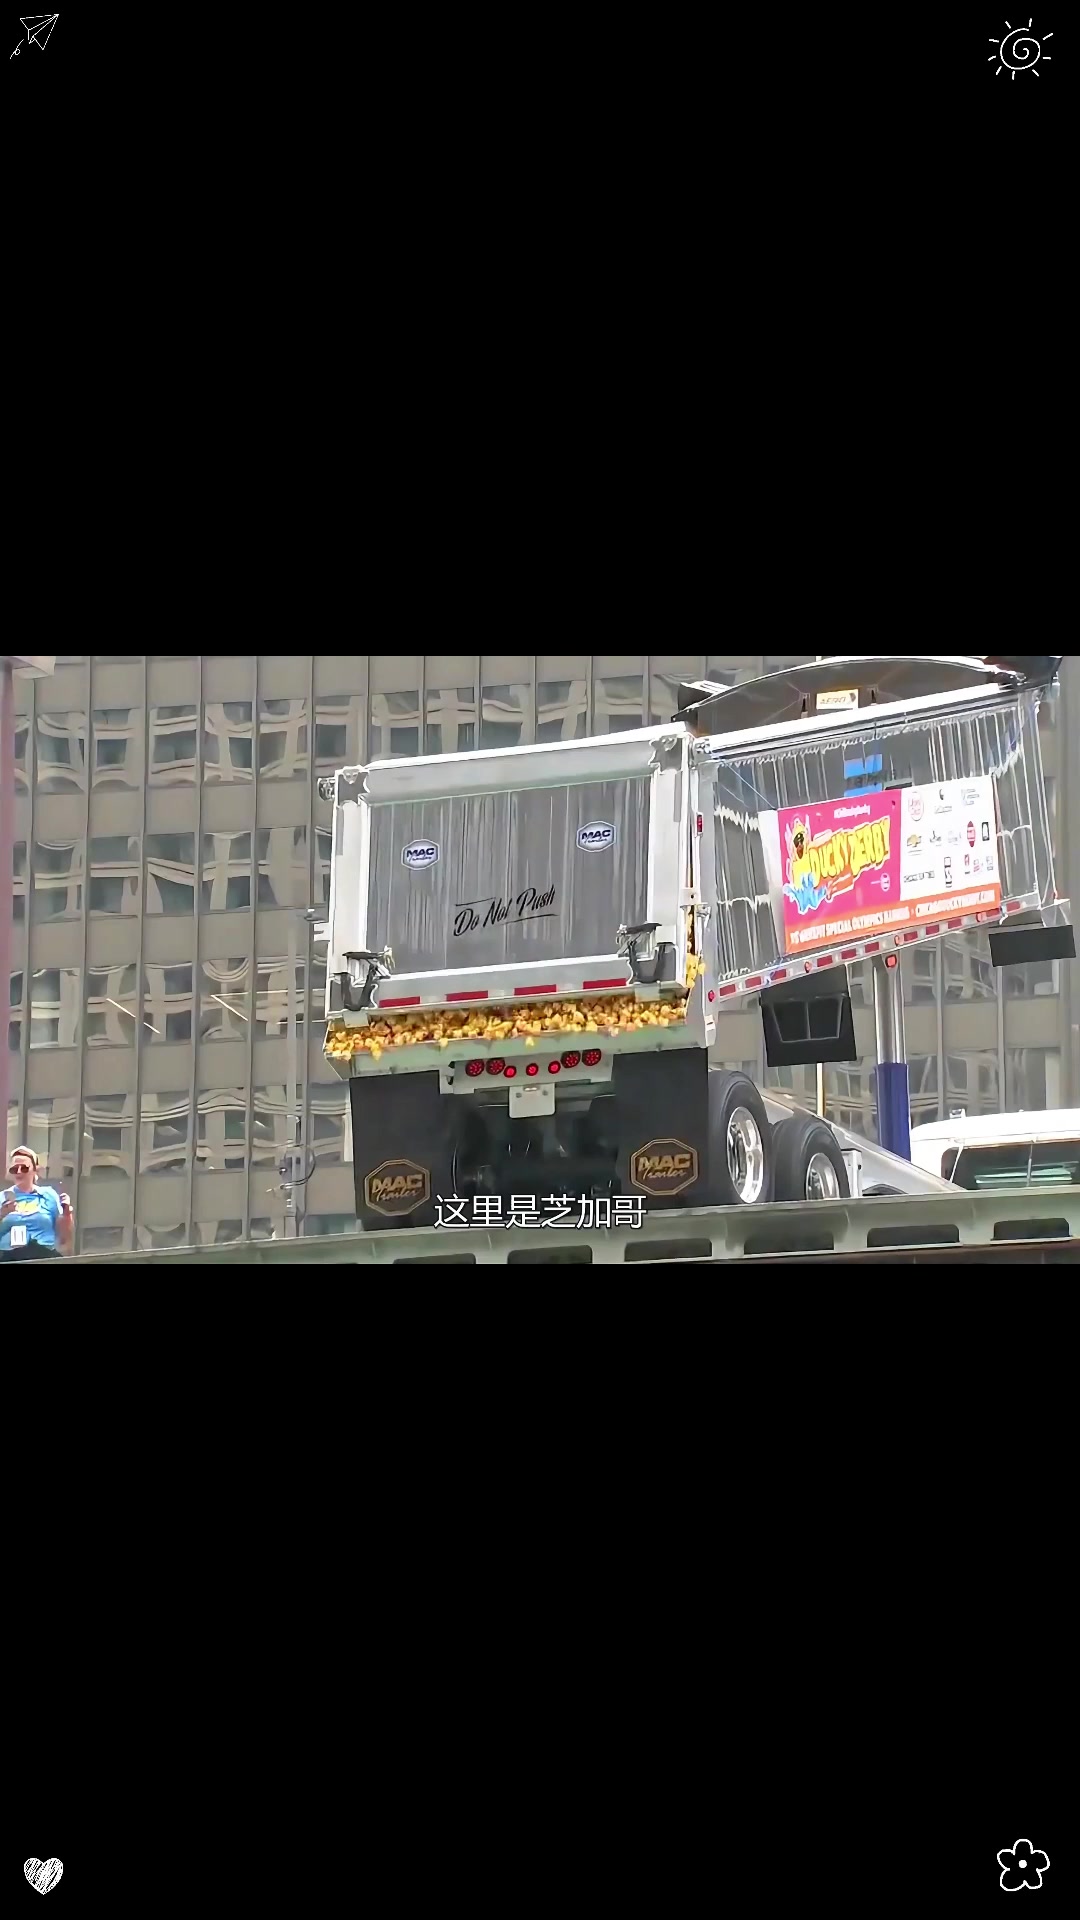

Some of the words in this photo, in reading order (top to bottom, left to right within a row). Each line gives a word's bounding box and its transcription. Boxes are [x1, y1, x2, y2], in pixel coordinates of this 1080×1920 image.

[581, 829, 611, 840] MAC
[406, 848, 435, 858] MAC
[808, 831, 849, 889] DUCKY
[849, 816, 890, 878] DERBY
[453, 908, 479, 937] Do
[483, 898, 513, 928] Not
[516, 885, 556, 917] Push
[638, 1153, 691, 1172] MAC
[372, 1173, 423, 1193] MAC
